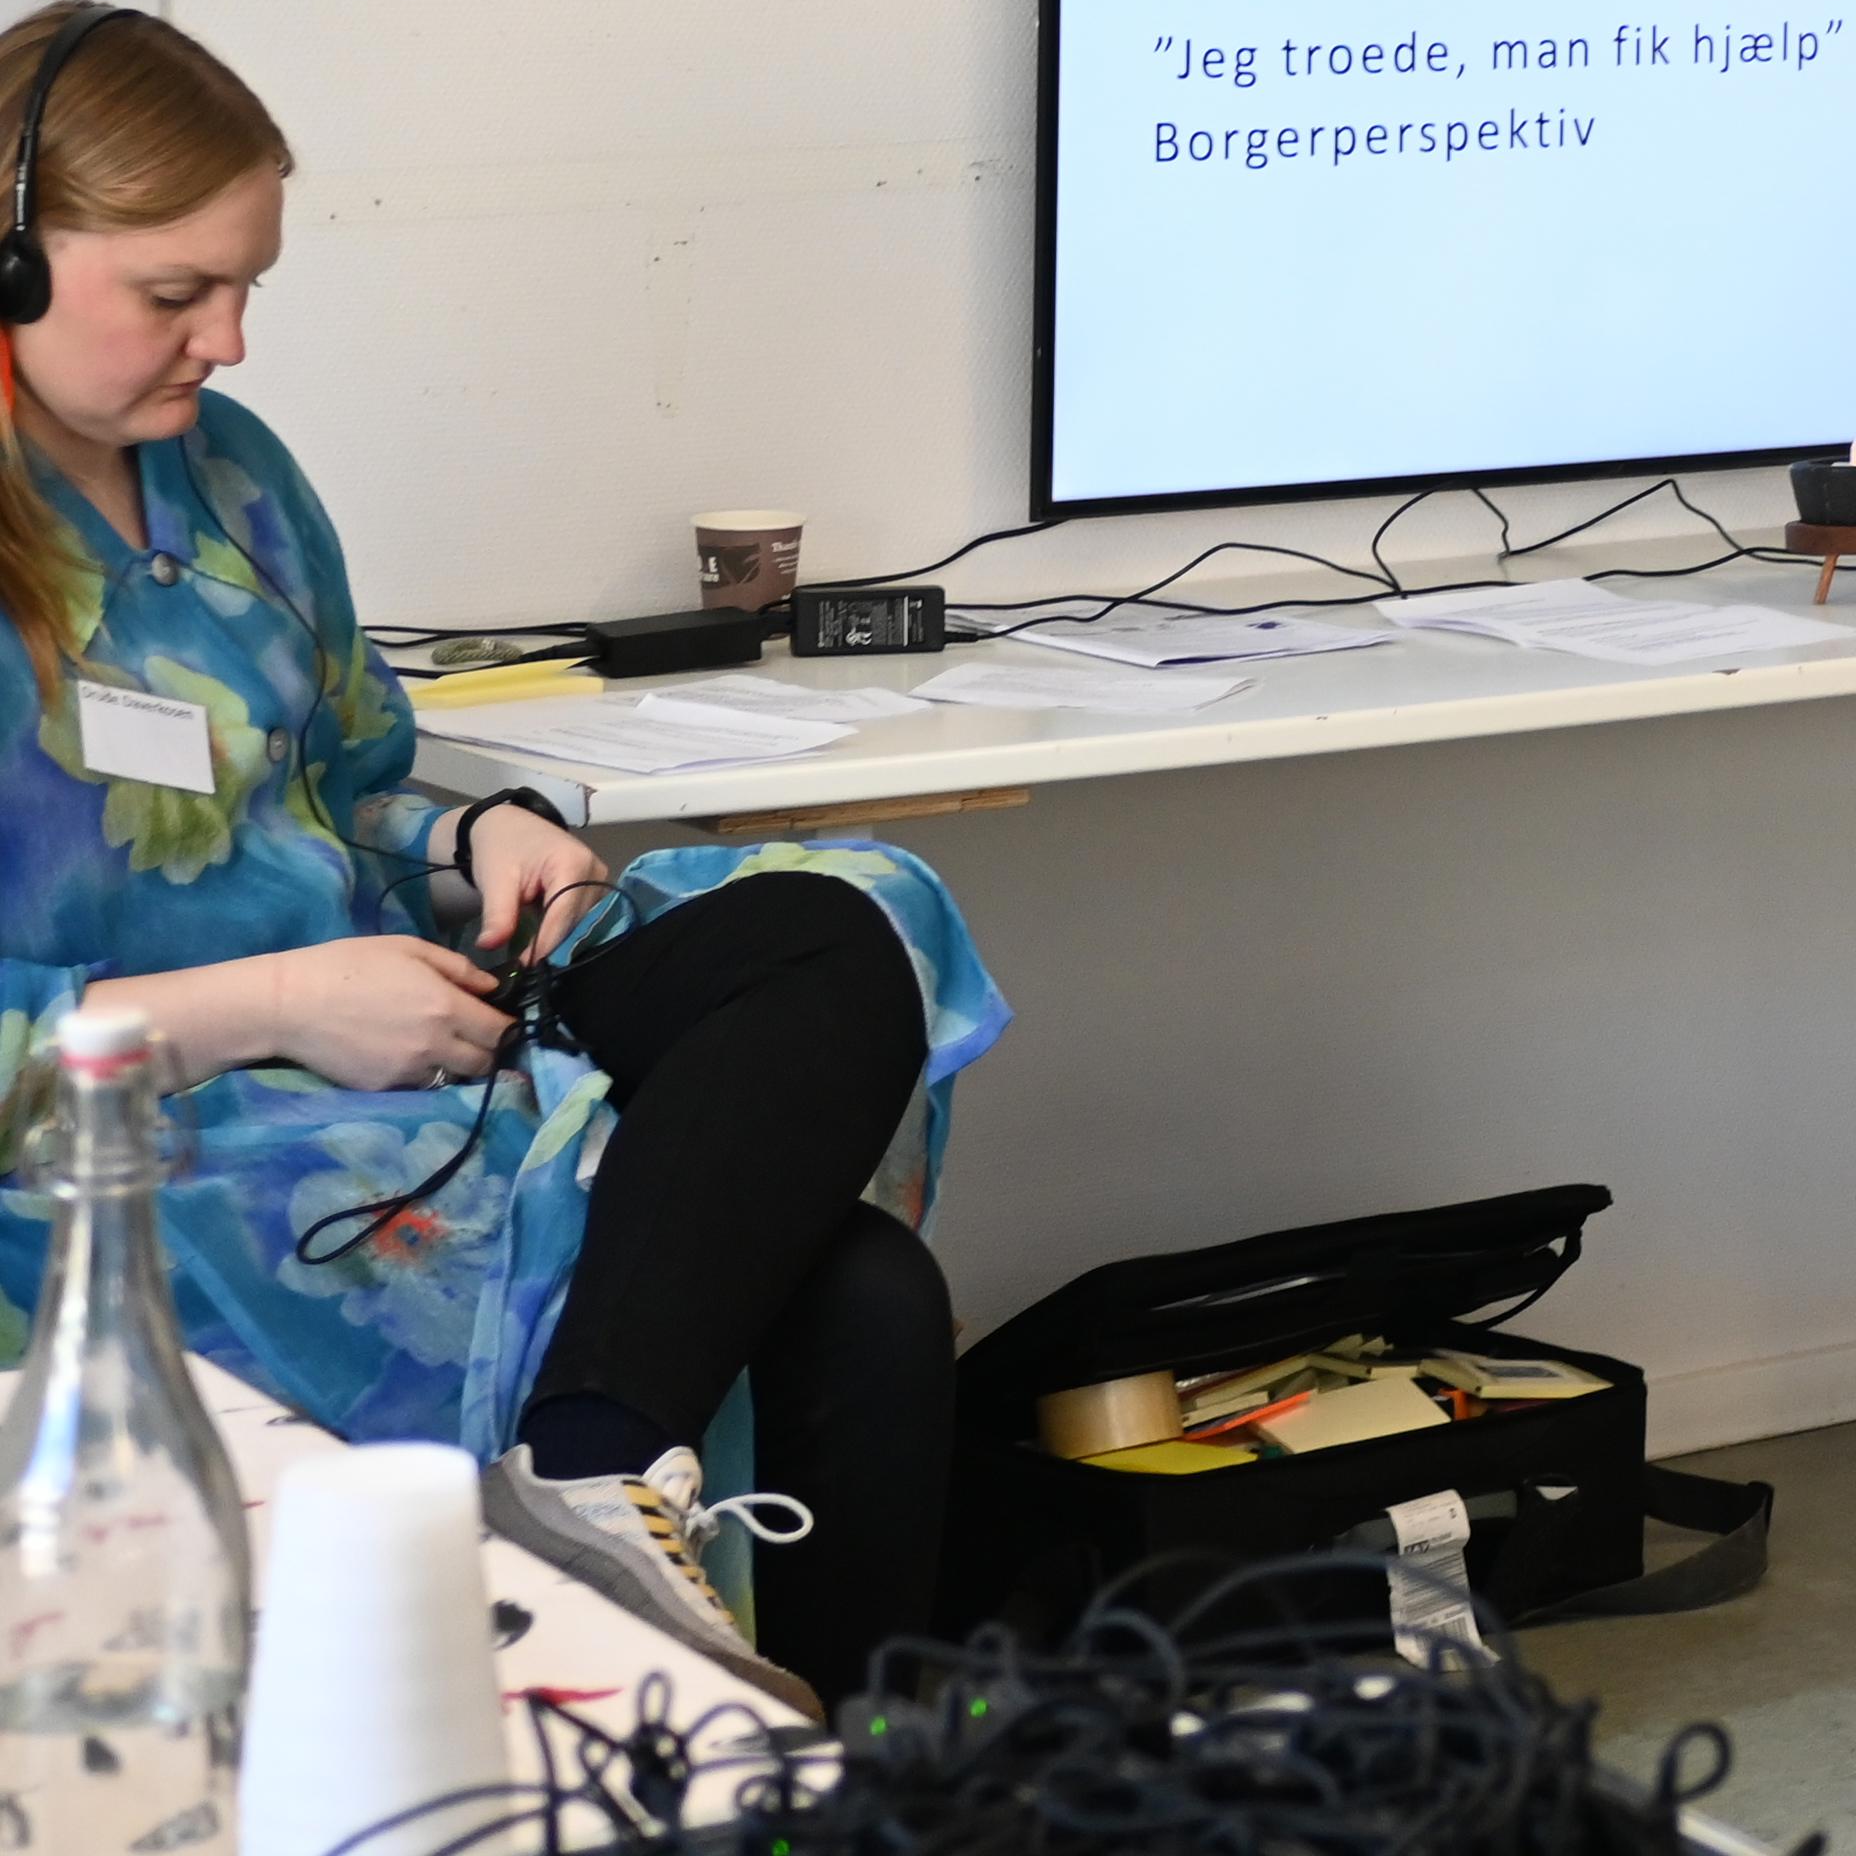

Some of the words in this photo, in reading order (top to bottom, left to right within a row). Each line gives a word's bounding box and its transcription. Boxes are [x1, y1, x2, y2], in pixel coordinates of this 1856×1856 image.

[1280, 30, 1466, 80] troede,
[1492, 37, 1589, 71] man
[1612, 24, 1670, 67] fik
[1155, 107, 1596, 170] Borgerperspektiv
